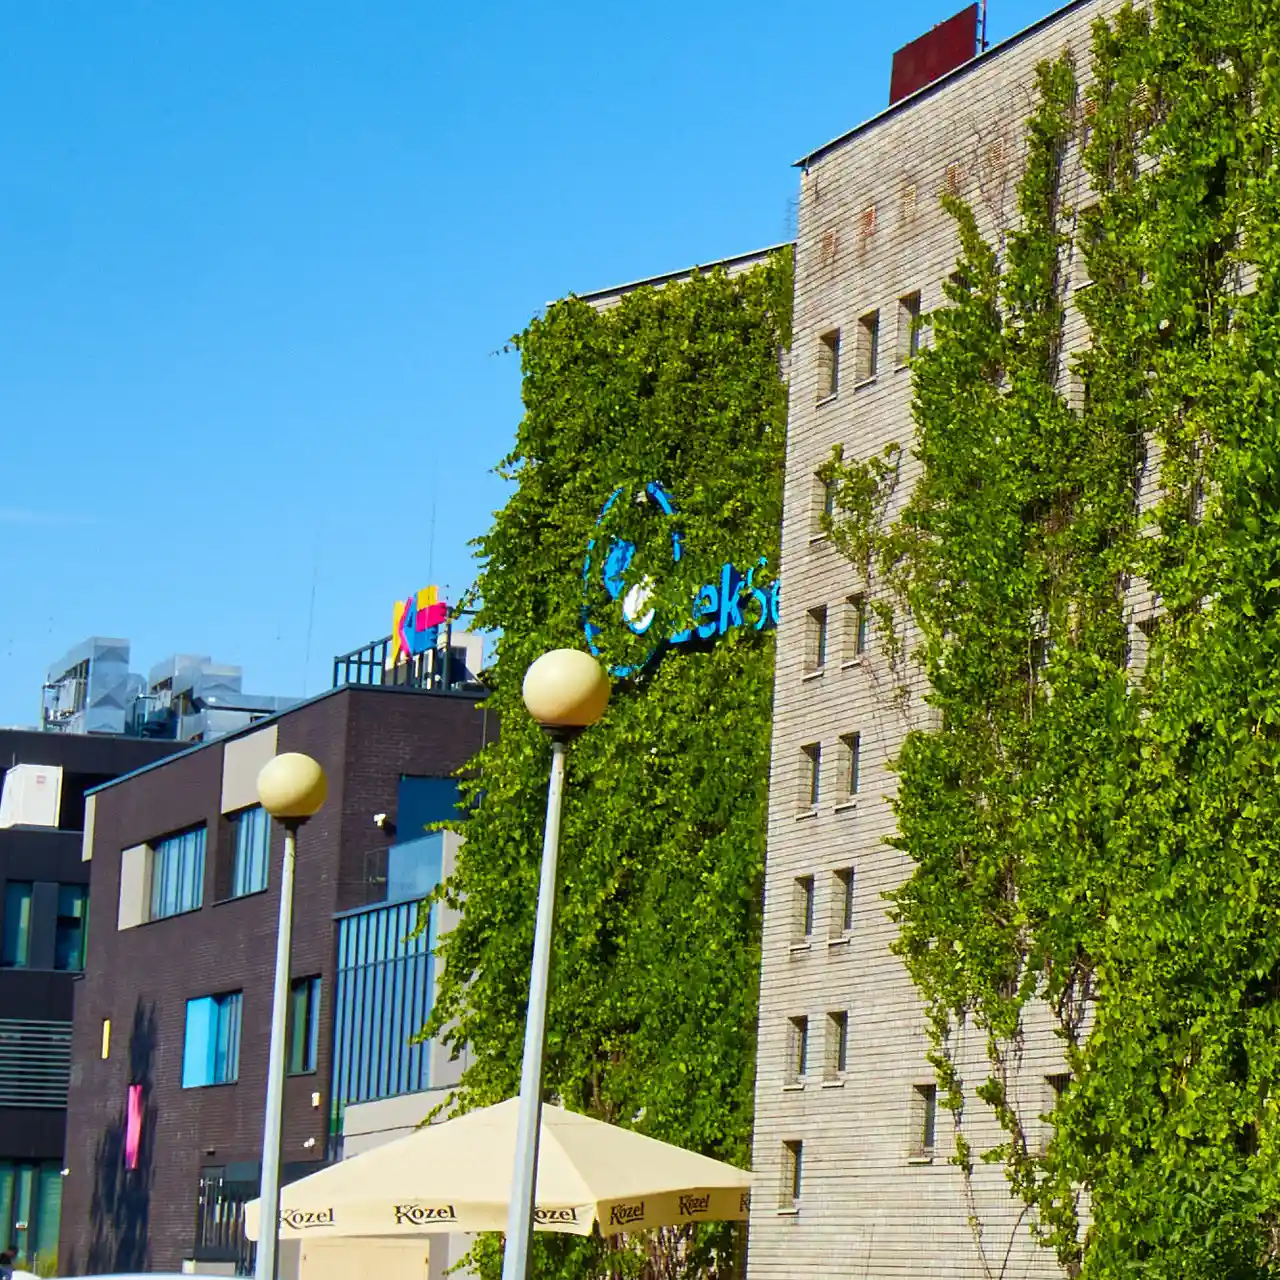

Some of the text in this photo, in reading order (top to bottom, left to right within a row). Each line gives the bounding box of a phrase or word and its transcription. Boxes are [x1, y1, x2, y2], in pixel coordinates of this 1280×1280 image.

[394, 1204, 458, 1225] Kozel
[609, 1201, 645, 1226] Kozel
[679, 1194, 710, 1216] Kozel
[534, 1207, 579, 1225] ozel
